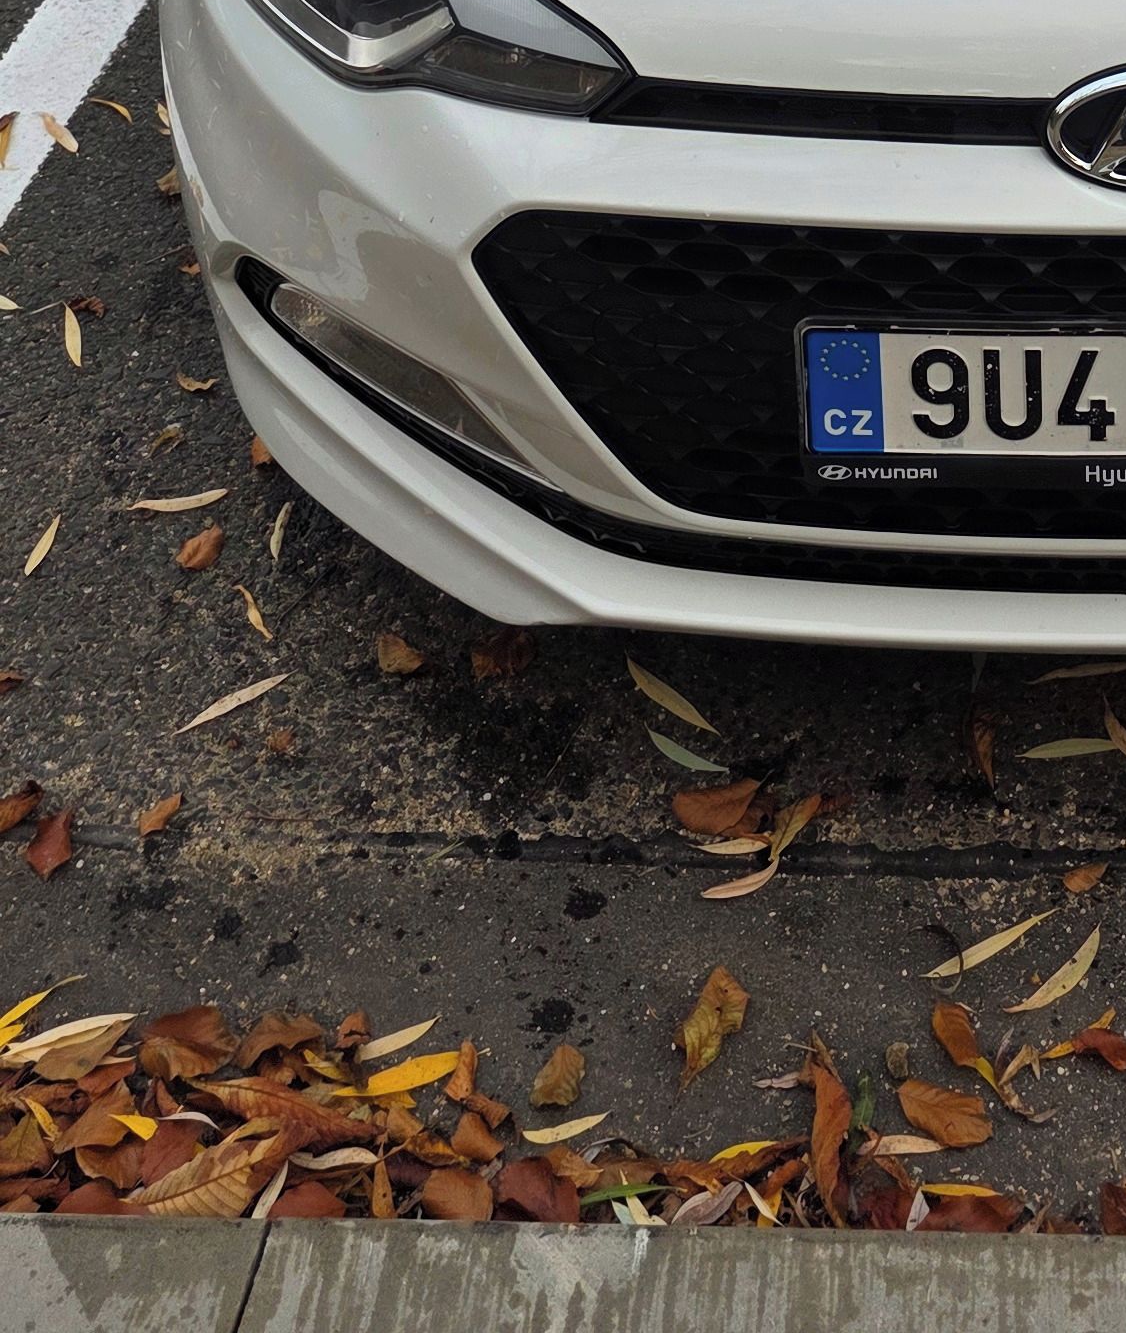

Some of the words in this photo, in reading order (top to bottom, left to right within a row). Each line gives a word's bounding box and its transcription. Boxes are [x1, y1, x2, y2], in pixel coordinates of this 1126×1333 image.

[911, 348, 1117, 441] 9U4
[823, 408, 873, 436] CZ
[855, 467, 938, 479] HYUNDAI
